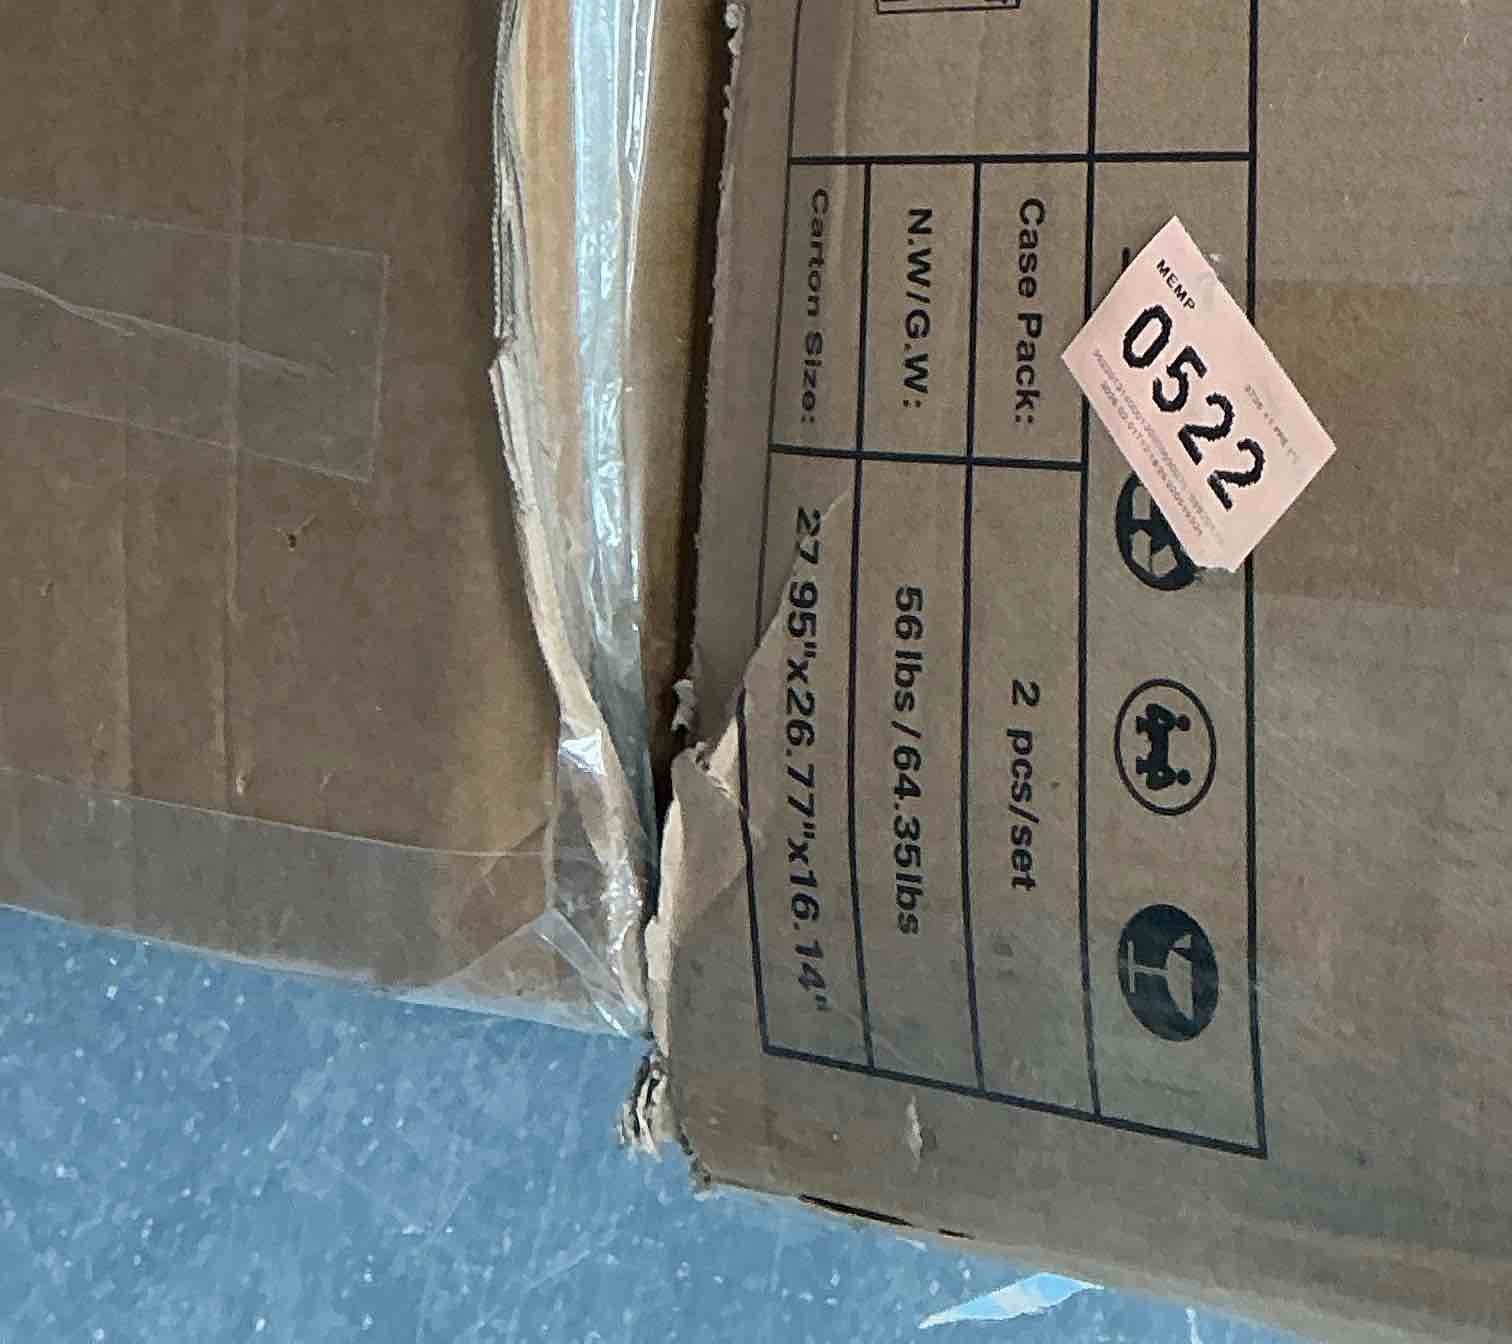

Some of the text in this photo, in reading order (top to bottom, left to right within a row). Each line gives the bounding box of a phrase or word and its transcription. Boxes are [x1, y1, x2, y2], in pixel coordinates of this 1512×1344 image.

[800, 188, 830, 424] Carton Size:
[1015, 197, 1046, 425] Case Pack:
[1157, 260, 1195, 308] MEMP
[1123, 305, 1265, 512] 0522
[1006, 679, 1041, 892] 2 pcs/set
